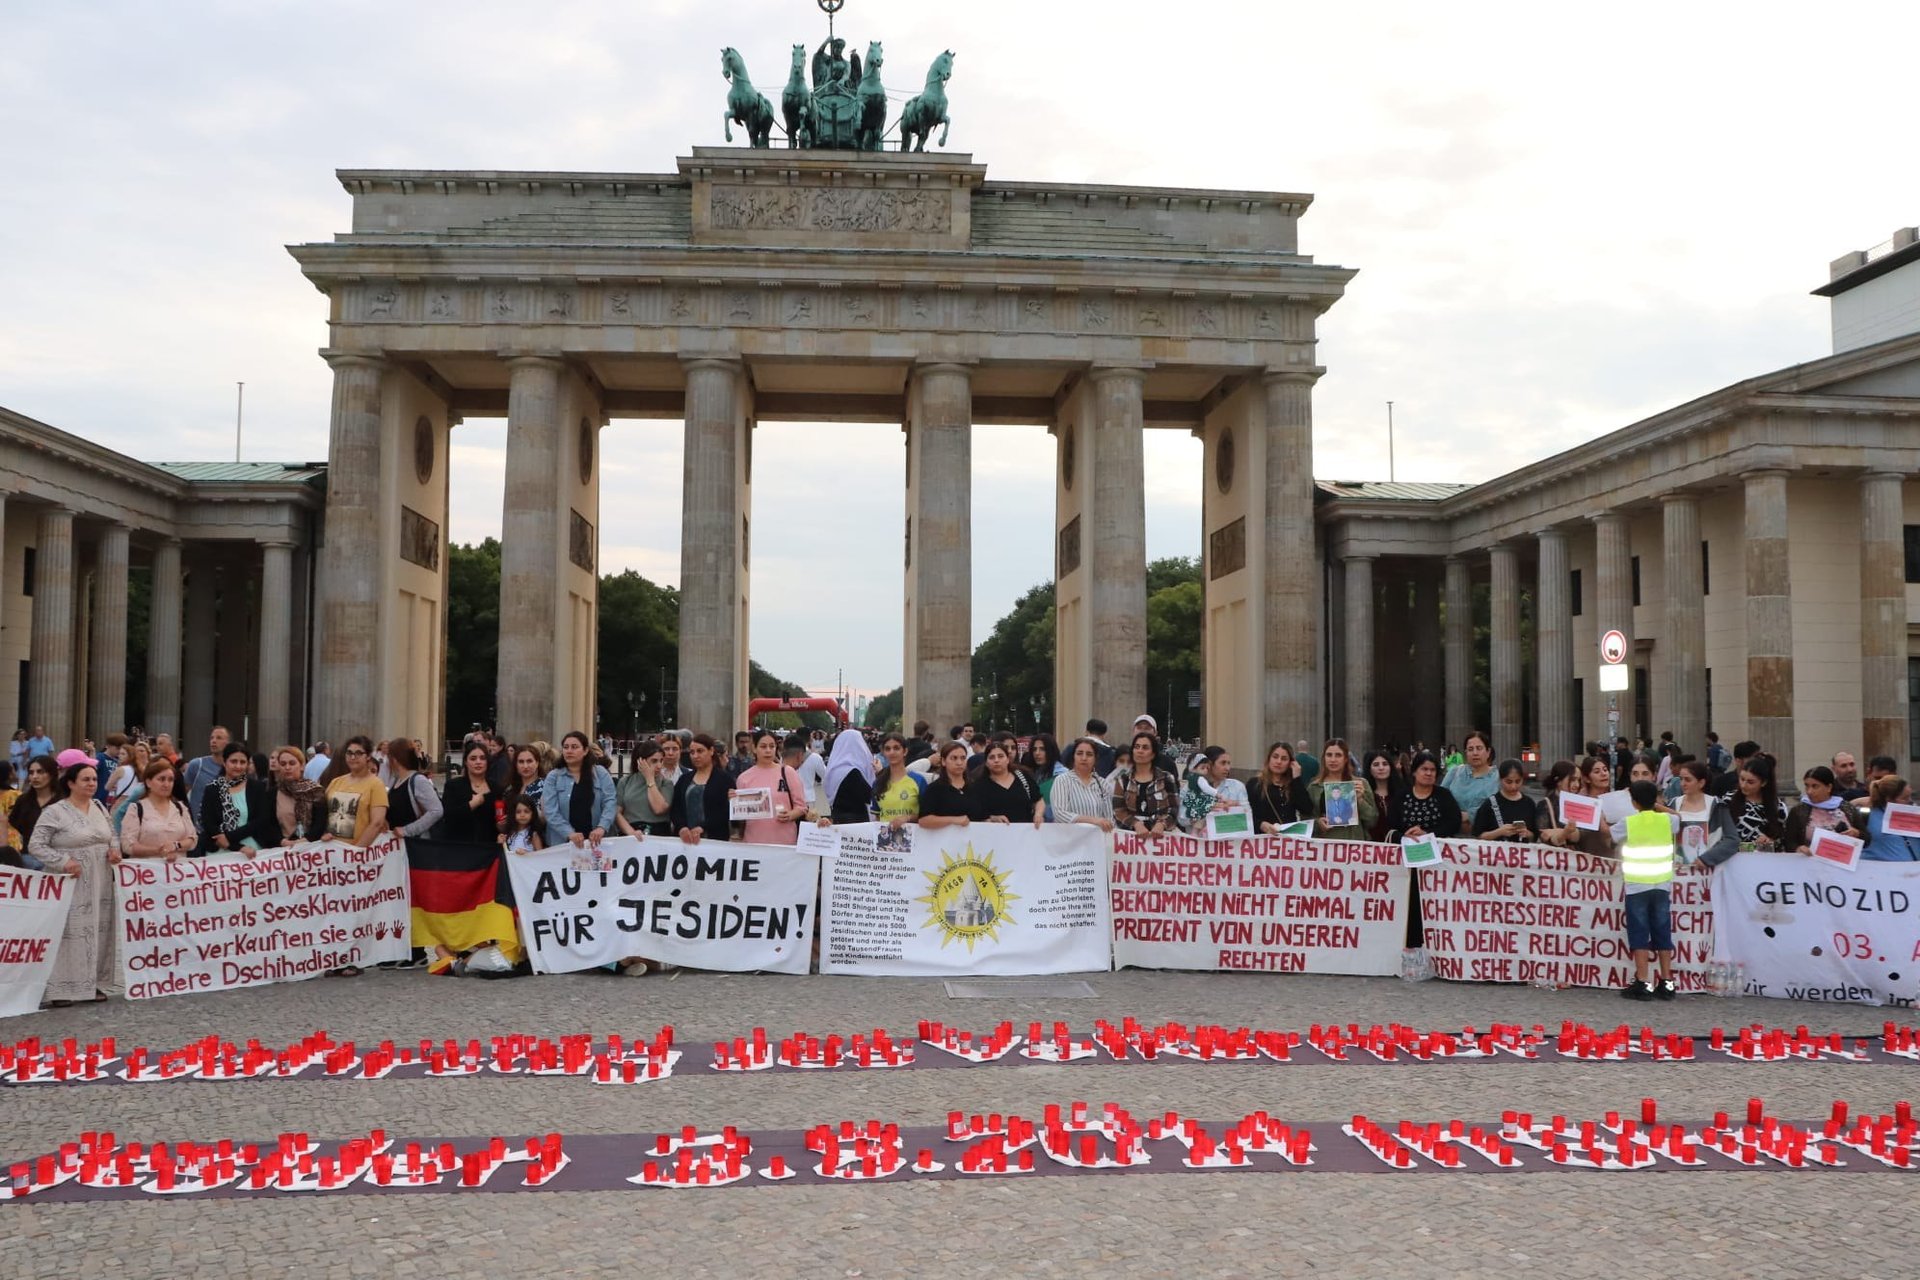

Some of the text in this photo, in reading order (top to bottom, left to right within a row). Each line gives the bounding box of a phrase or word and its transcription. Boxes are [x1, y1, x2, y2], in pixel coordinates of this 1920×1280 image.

[119, 864, 156, 887] Die
[164, 849, 335, 884] IS-Vergewaltiger
[835, 860, 871, 869] Jesidinnen
[840, 852, 878, 862] ölkermords
[1438, 842, 1471, 864] AS
[1478, 845, 1531, 869] HABE
[1537, 849, 1569, 872] ICH
[1576, 853, 1617, 875] DAV
[834, 868, 853, 876] durch
[870, 872, 893, 880] Angriff
[1055, 871, 1068, 879] und
[1136, 861, 1233, 887] UNSEREM
[1239, 864, 1293, 889] LAND
[1300, 867, 1344, 891] UND
[1419, 869, 1447, 893] ICH
[1452, 871, 1515, 897] MEINE
[1522, 874, 1613, 902] RELIGION
[125, 891, 155, 912] die
[165, 876, 279, 909] entführten
[1111, 889, 1216, 915] BEKOMMEN
[1755, 881, 1909, 913] GENOZID
[126, 912, 223, 942] Mädchen
[229, 904, 257, 927] als
[532, 912, 595, 951] FÜR
[865, 913, 890, 921] diesem
[893, 914, 905, 922] Tag
[1422, 898, 1448, 922] ICH
[1671, 911, 1713, 934] ICHT
[129, 946, 188, 971] oder
[320, 925, 347, 944] sie
[352, 923, 373, 939] an
[1113, 917, 1360, 949] PROZENT VON UNSEREN
[1832, 932, 1886, 962] 03.
[129, 947, 361, 998] andere Dschihadisten
[1218, 949, 1306, 972] RECHTEN
[1471, 958, 1512, 980] SEHE
[1519, 960, 1559, 982] DICH
[1565, 963, 1601, 986] NUR
[1785, 982, 1873, 1001] werden
